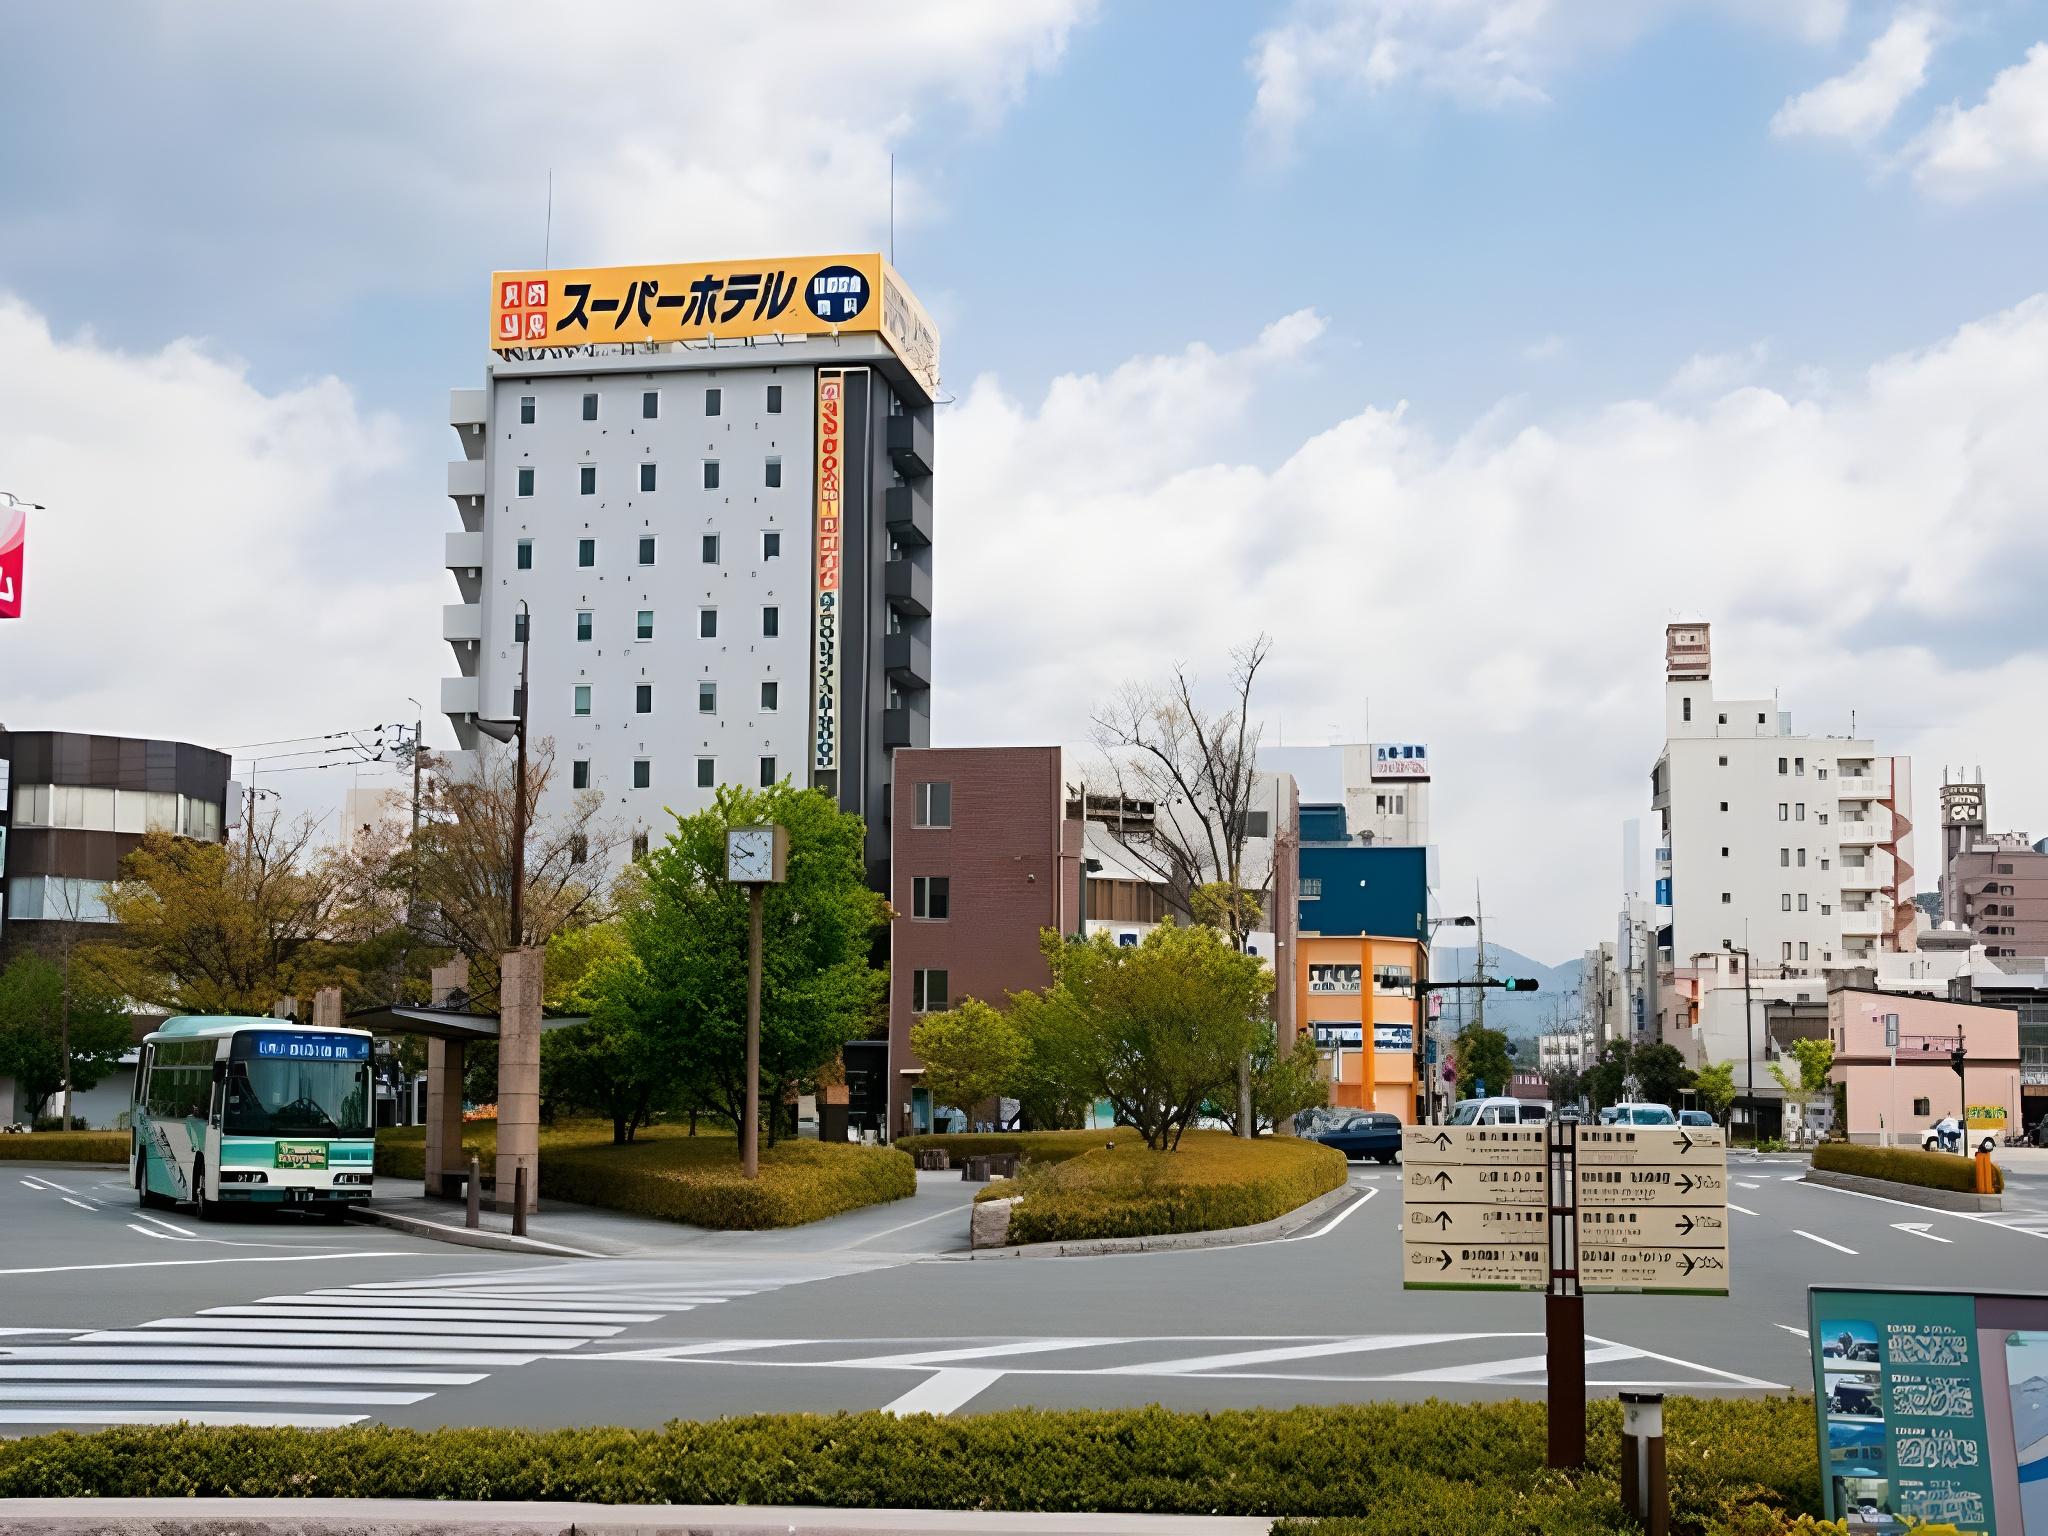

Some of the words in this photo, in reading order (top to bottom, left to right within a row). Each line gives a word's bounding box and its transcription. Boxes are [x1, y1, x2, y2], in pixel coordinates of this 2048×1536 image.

[556, 271, 797, 330] スーパーホテル
